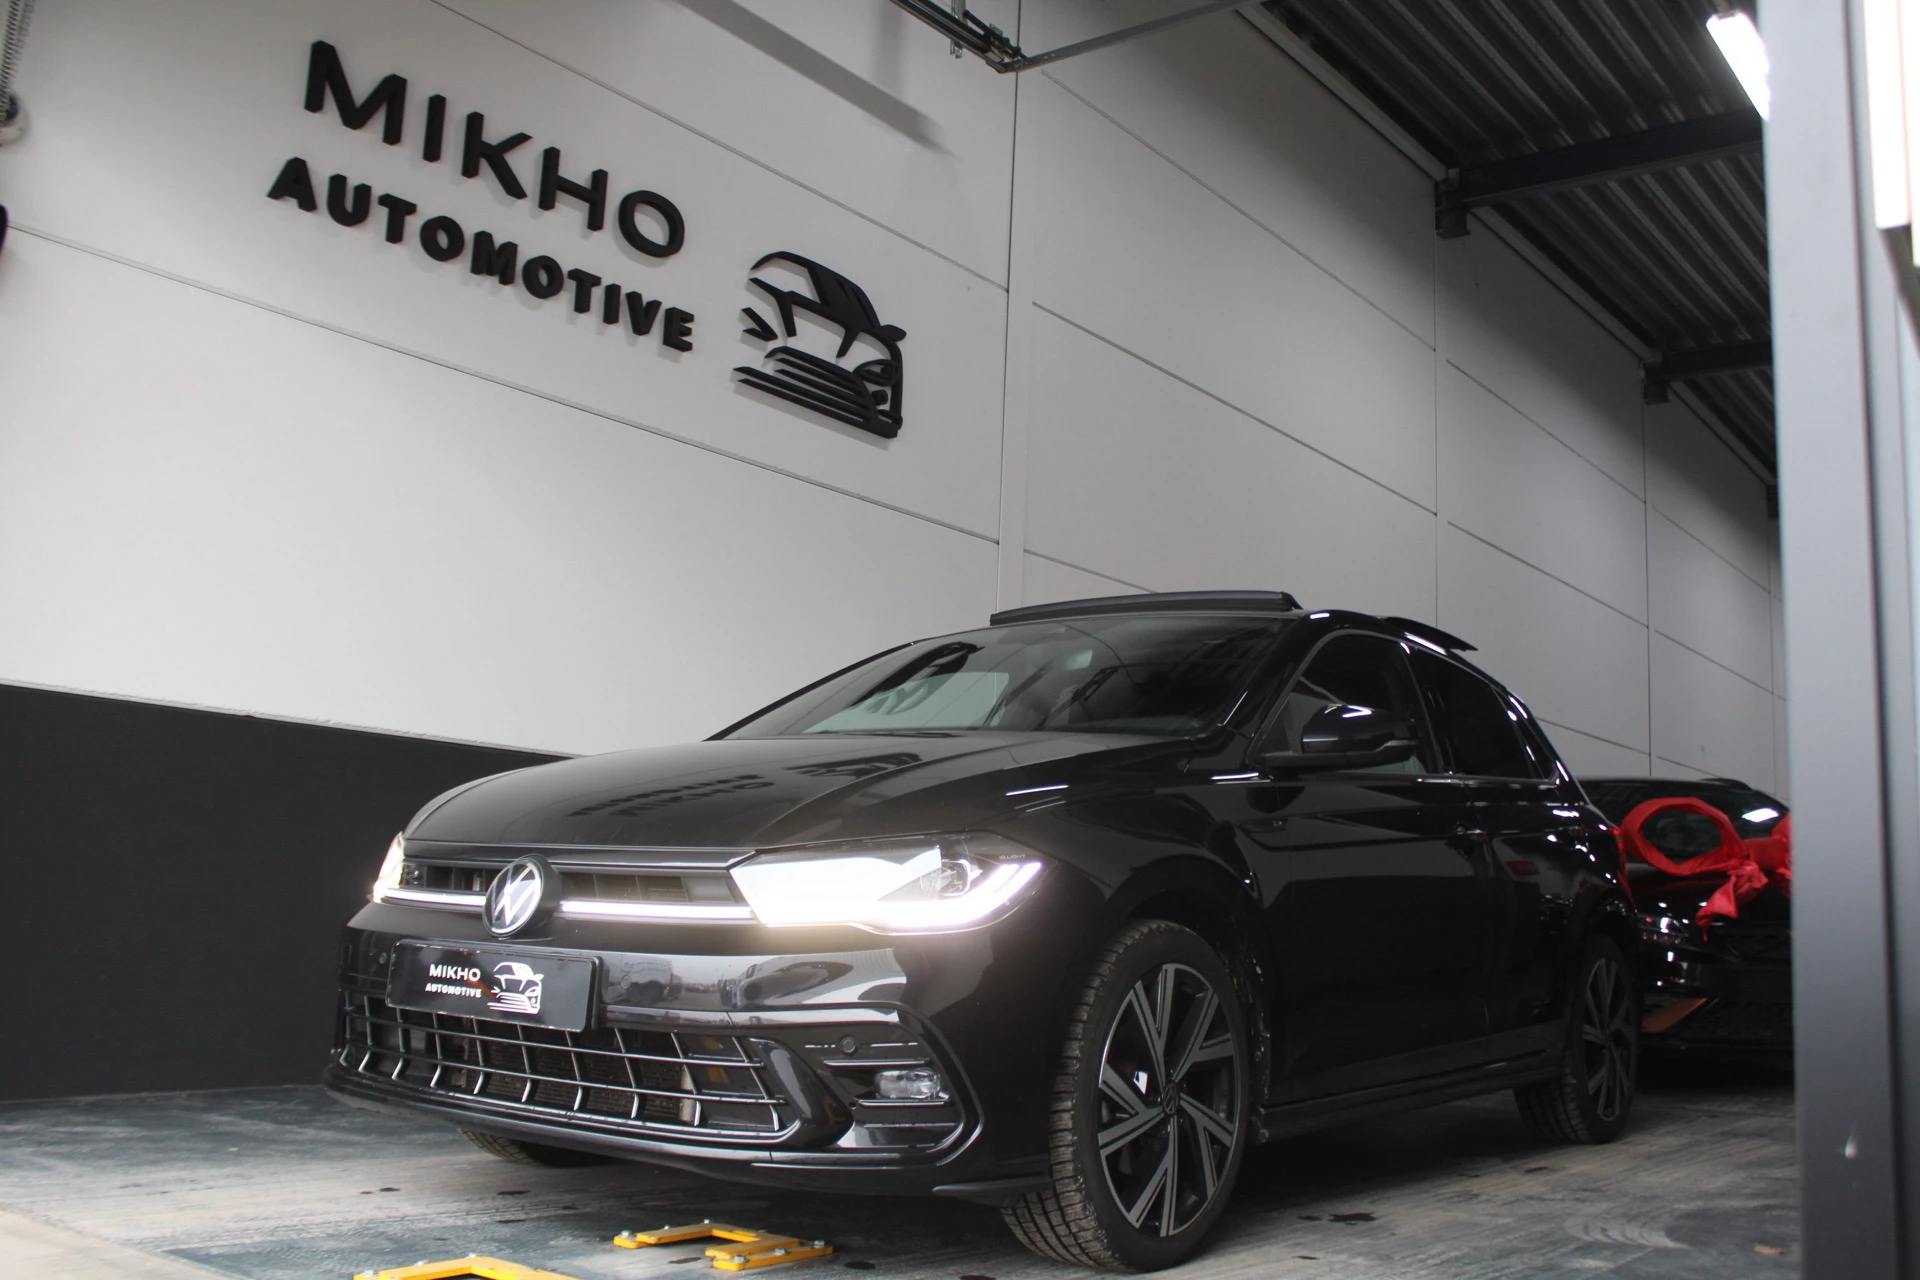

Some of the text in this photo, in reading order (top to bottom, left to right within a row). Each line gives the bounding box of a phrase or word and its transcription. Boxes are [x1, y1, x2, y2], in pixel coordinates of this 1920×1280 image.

[303, 39, 685, 259] MIKHO
[267, 156, 695, 353] AUTOMOTIVE
[424, 982, 483, 999] AUTOMOTIVE
[429, 963, 482, 982] MIKHO
